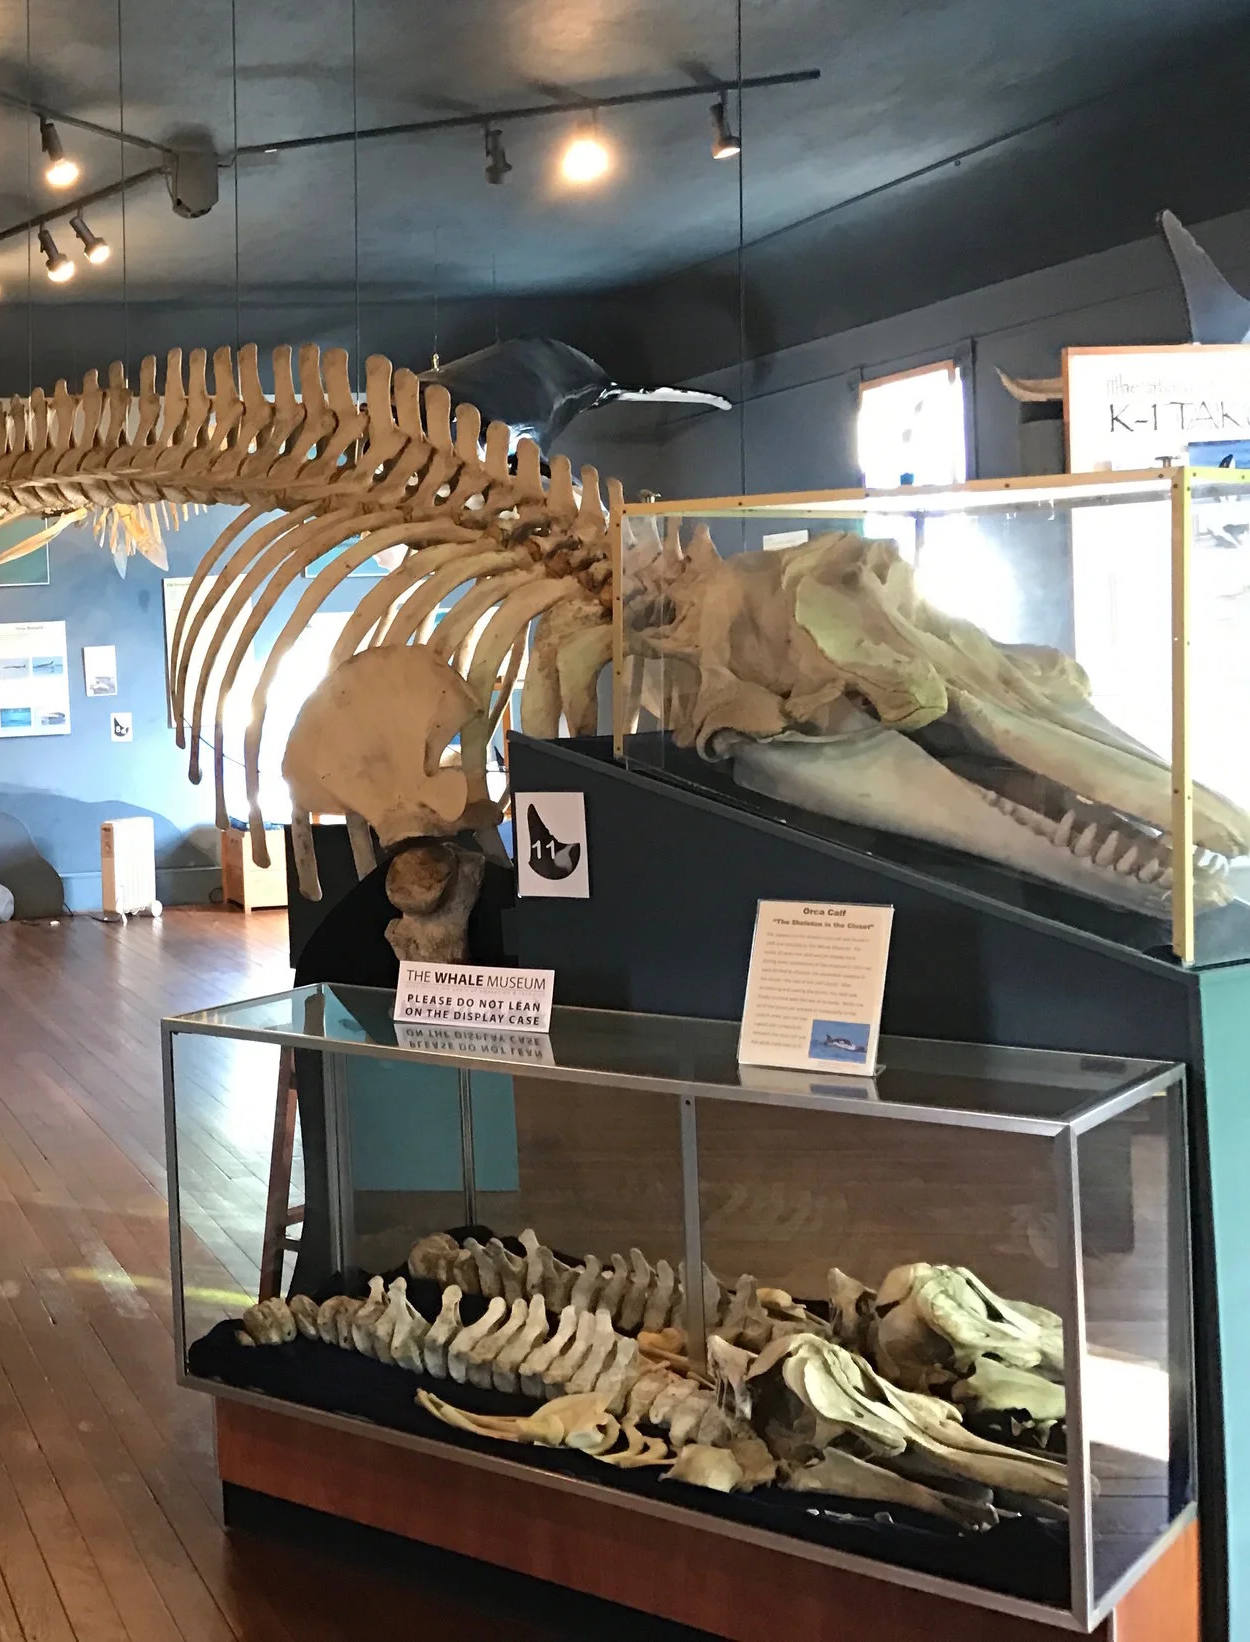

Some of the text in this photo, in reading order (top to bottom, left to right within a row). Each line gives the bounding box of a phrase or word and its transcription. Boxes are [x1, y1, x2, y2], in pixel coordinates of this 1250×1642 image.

[1110, 401, 1250, 432] K-1 TAK
[531, 839, 555, 860] 11
[803, 907, 847, 918] Orca Calf
[792, 919, 823, 928] Skeleton
[406, 969, 431, 983] THE
[434, 971, 484, 987] WHALE
[486, 975, 546, 990] MUSEUM
[407, 993, 541, 1012] PLEASE DO NOT LEAN
[405, 1007, 540, 1026] ON THE DISPLAY CASE
